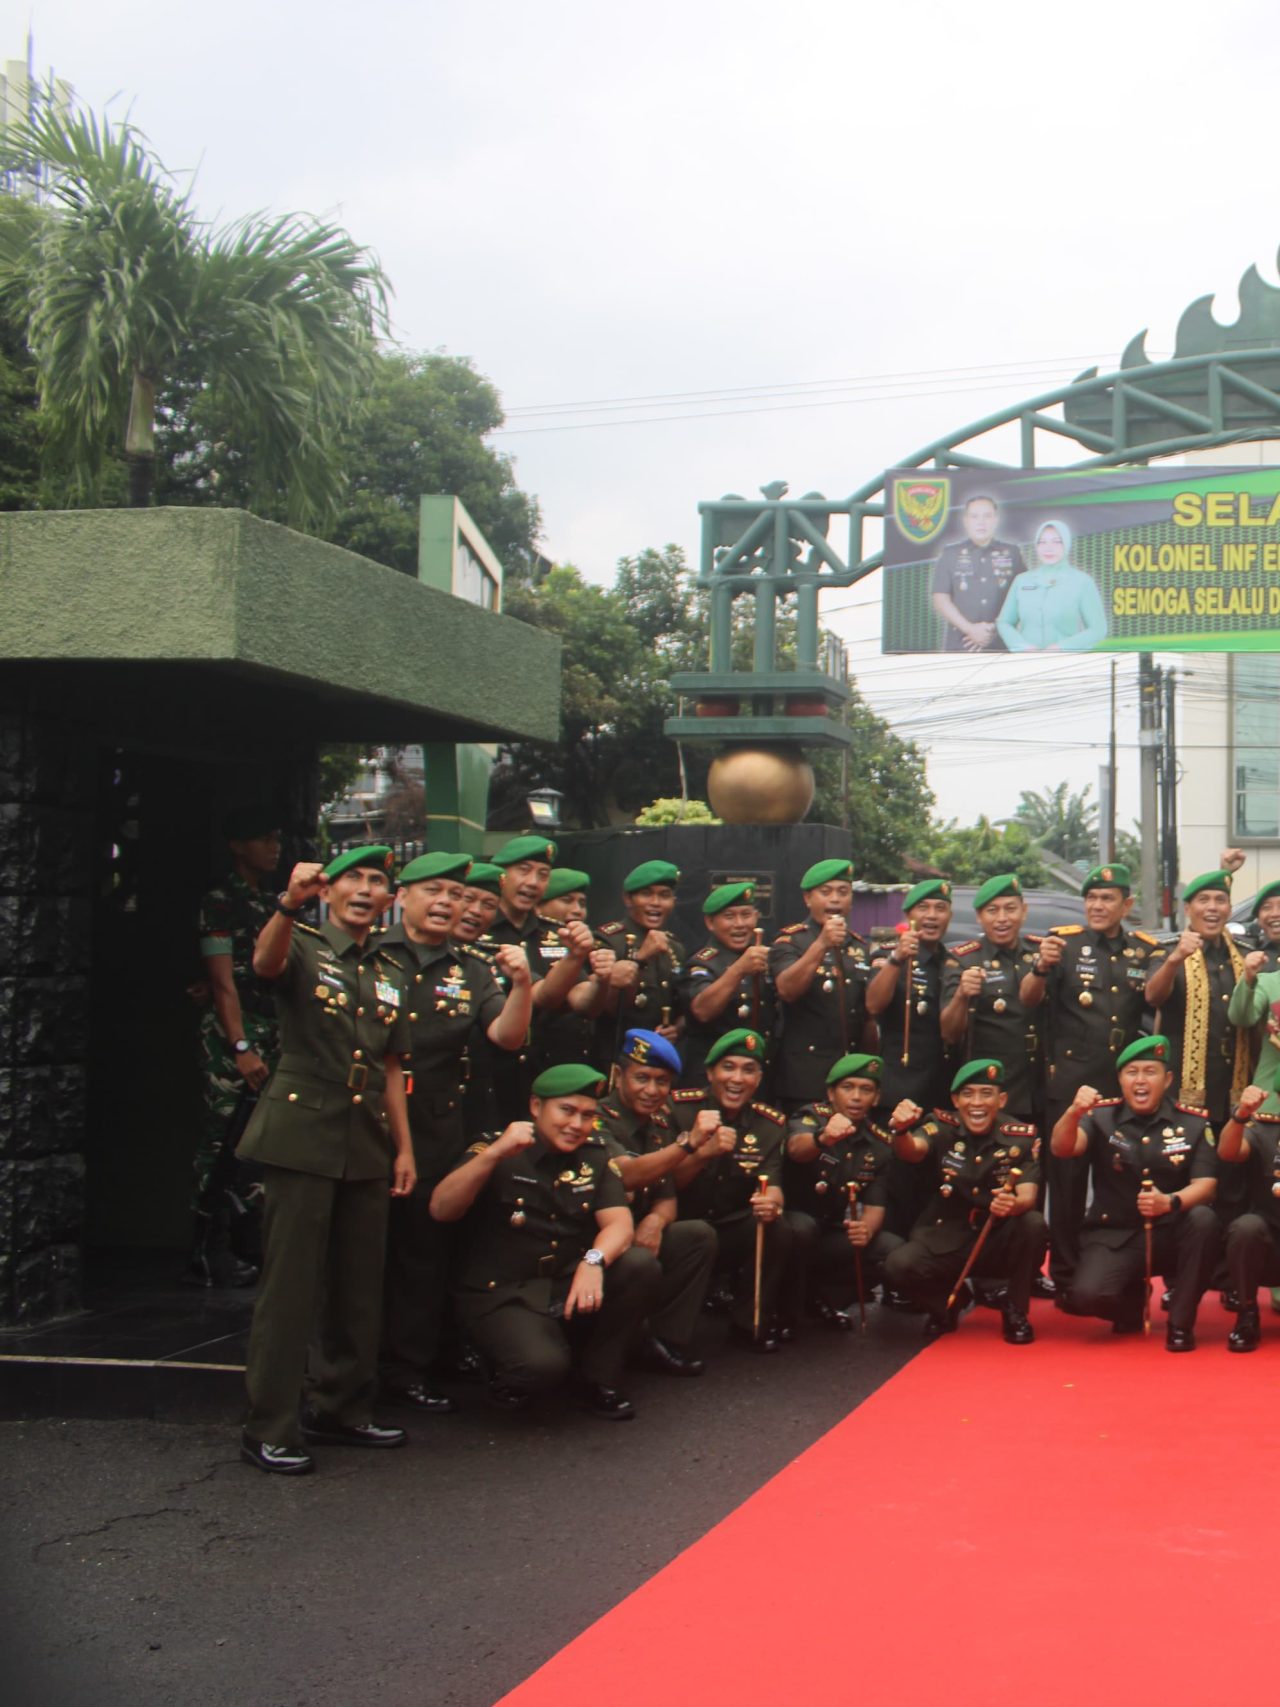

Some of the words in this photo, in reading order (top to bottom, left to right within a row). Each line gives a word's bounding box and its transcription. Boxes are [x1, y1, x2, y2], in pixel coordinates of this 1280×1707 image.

[1113, 544, 1218, 572] KOLONEL
[1222, 544, 1258, 572] INF
[1113, 586, 1191, 615] SEMOGA
[1194, 586, 1265, 615] SELALU
